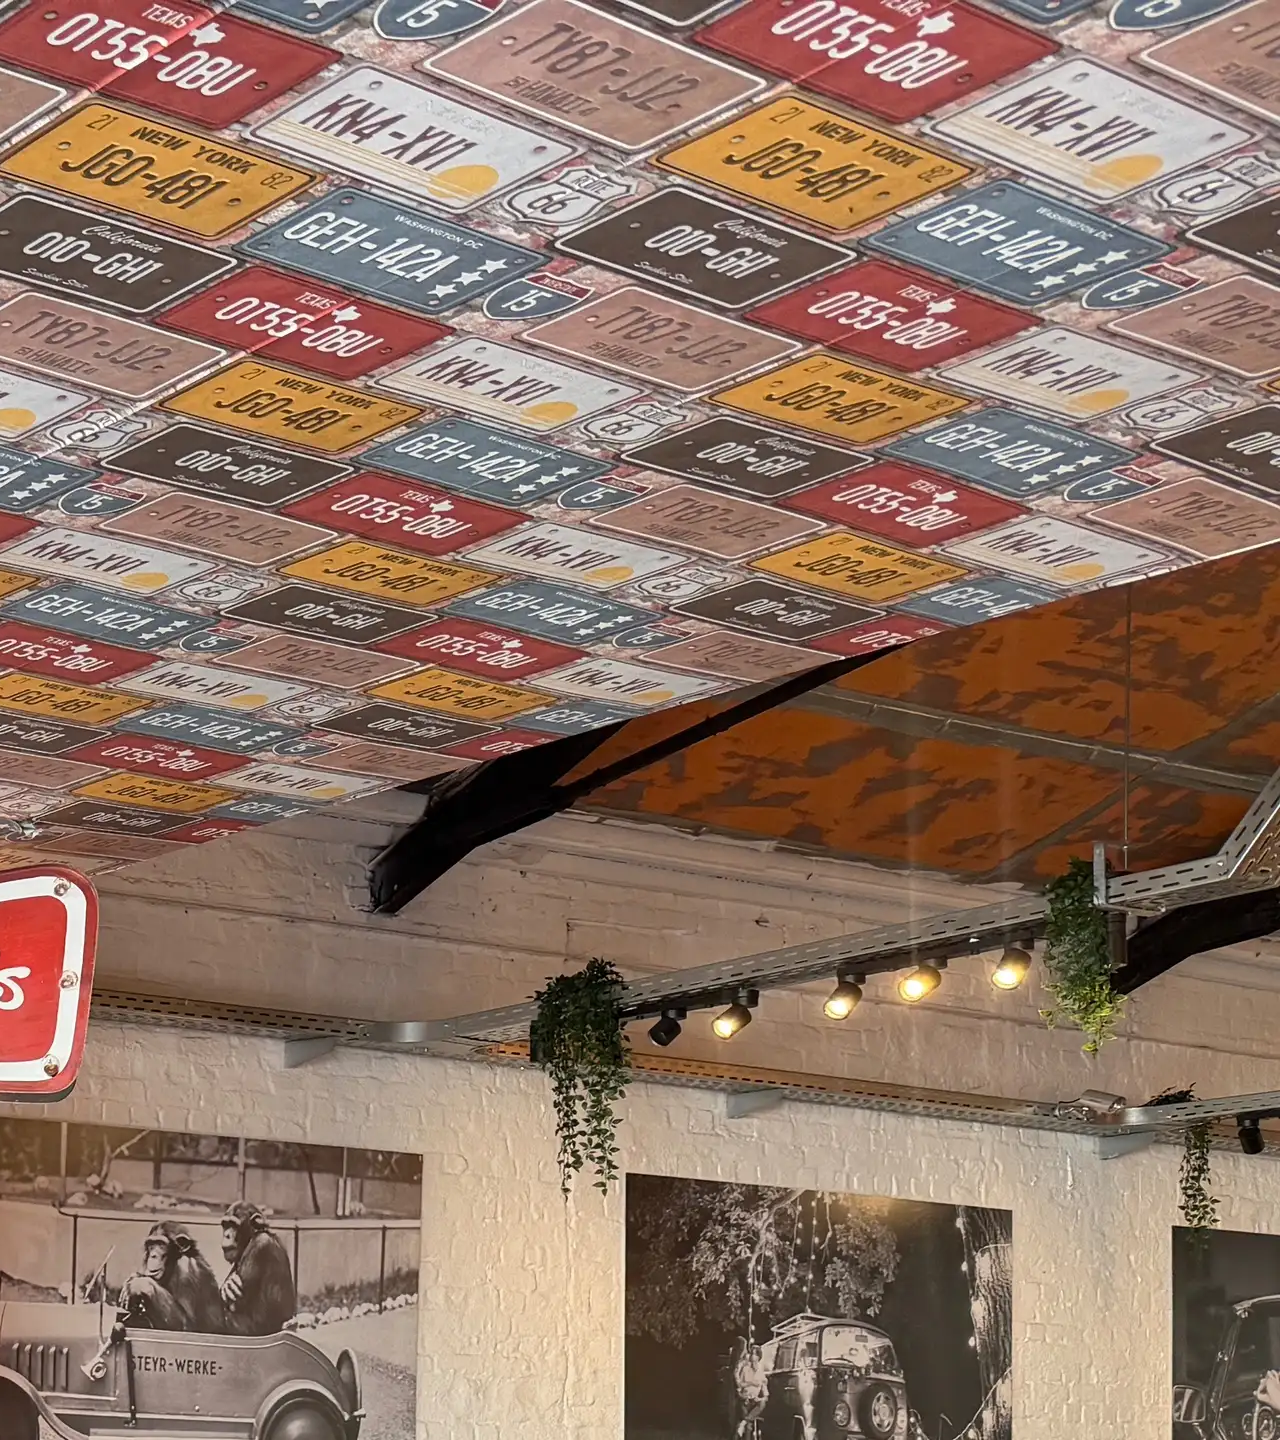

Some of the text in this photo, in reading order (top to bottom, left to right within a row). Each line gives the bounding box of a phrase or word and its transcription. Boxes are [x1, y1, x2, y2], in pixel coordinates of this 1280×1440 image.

[512, 23, 697, 111] TY87-JJ2
[299, 94, 477, 169] KN4-XV1
[984, 85, 1156, 162] KN4-XV1
[129, 126, 257, 173] NEW YORK
[526, 191, 580, 213] 66
[284, 212, 460, 279] GEH-142A
[917, 204, 1085, 272] GEH-142A
[295, 292, 336, 308] TEXAS
[502, 290, 552, 310] 15
[1102, 279, 1159, 300] 15
[12, 311, 170, 369] TY87-JJ2
[594, 306, 745, 365] TY87-JJ2
[415, 354, 561, 406] KN4-XV1
[984, 347, 1126, 400] KN4-XV1
[395, 434, 541, 480] GEH-142A
[924, 422, 1066, 470] GEH-142A
[496, 534, 621, 572] KN4-XV1
[979, 529, 1100, 567] KN4-XV1
[475, 590, 600, 625] GEH-142A
